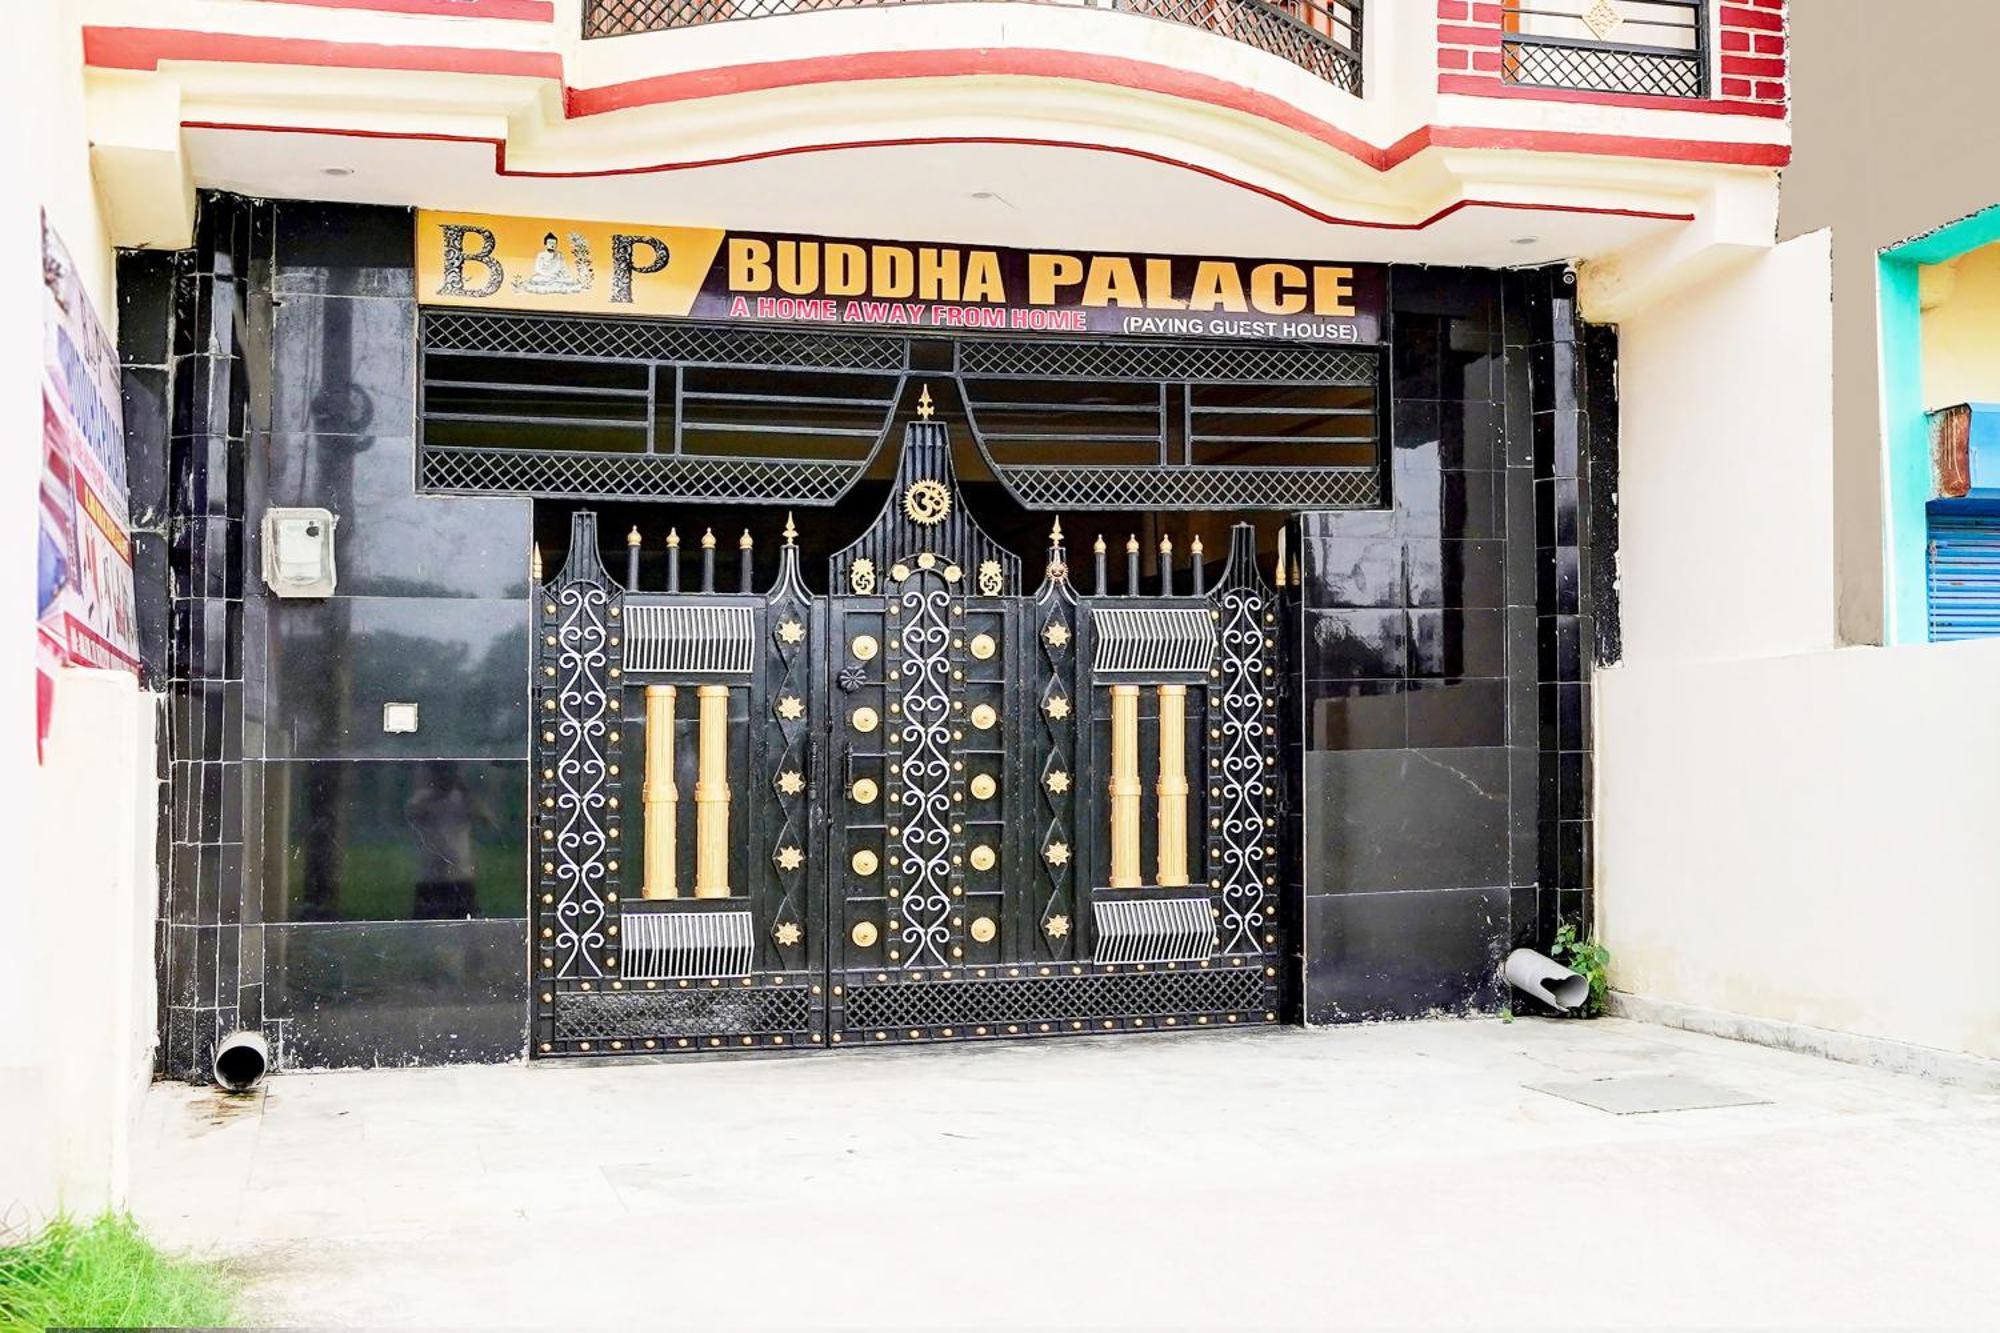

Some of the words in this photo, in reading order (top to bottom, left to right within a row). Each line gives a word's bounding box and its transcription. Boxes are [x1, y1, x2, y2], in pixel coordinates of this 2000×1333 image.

[436, 223, 505, 298] B
[608, 234, 671, 304] P
[728, 238, 1006, 303] BUDDHA
[1028, 253, 1356, 317] PALACE
[730, 296, 750, 318] A
[757, 296, 837, 321] HOME
[843, 301, 924, 325] AWAY
[931, 304, 1006, 329] FROM
[1011, 307, 1088, 332] HOME
[1122, 315, 1204, 336] (PAYING
[1209, 319, 1278, 338] GUEST
[1284, 323, 1360, 343] HOUSE)
